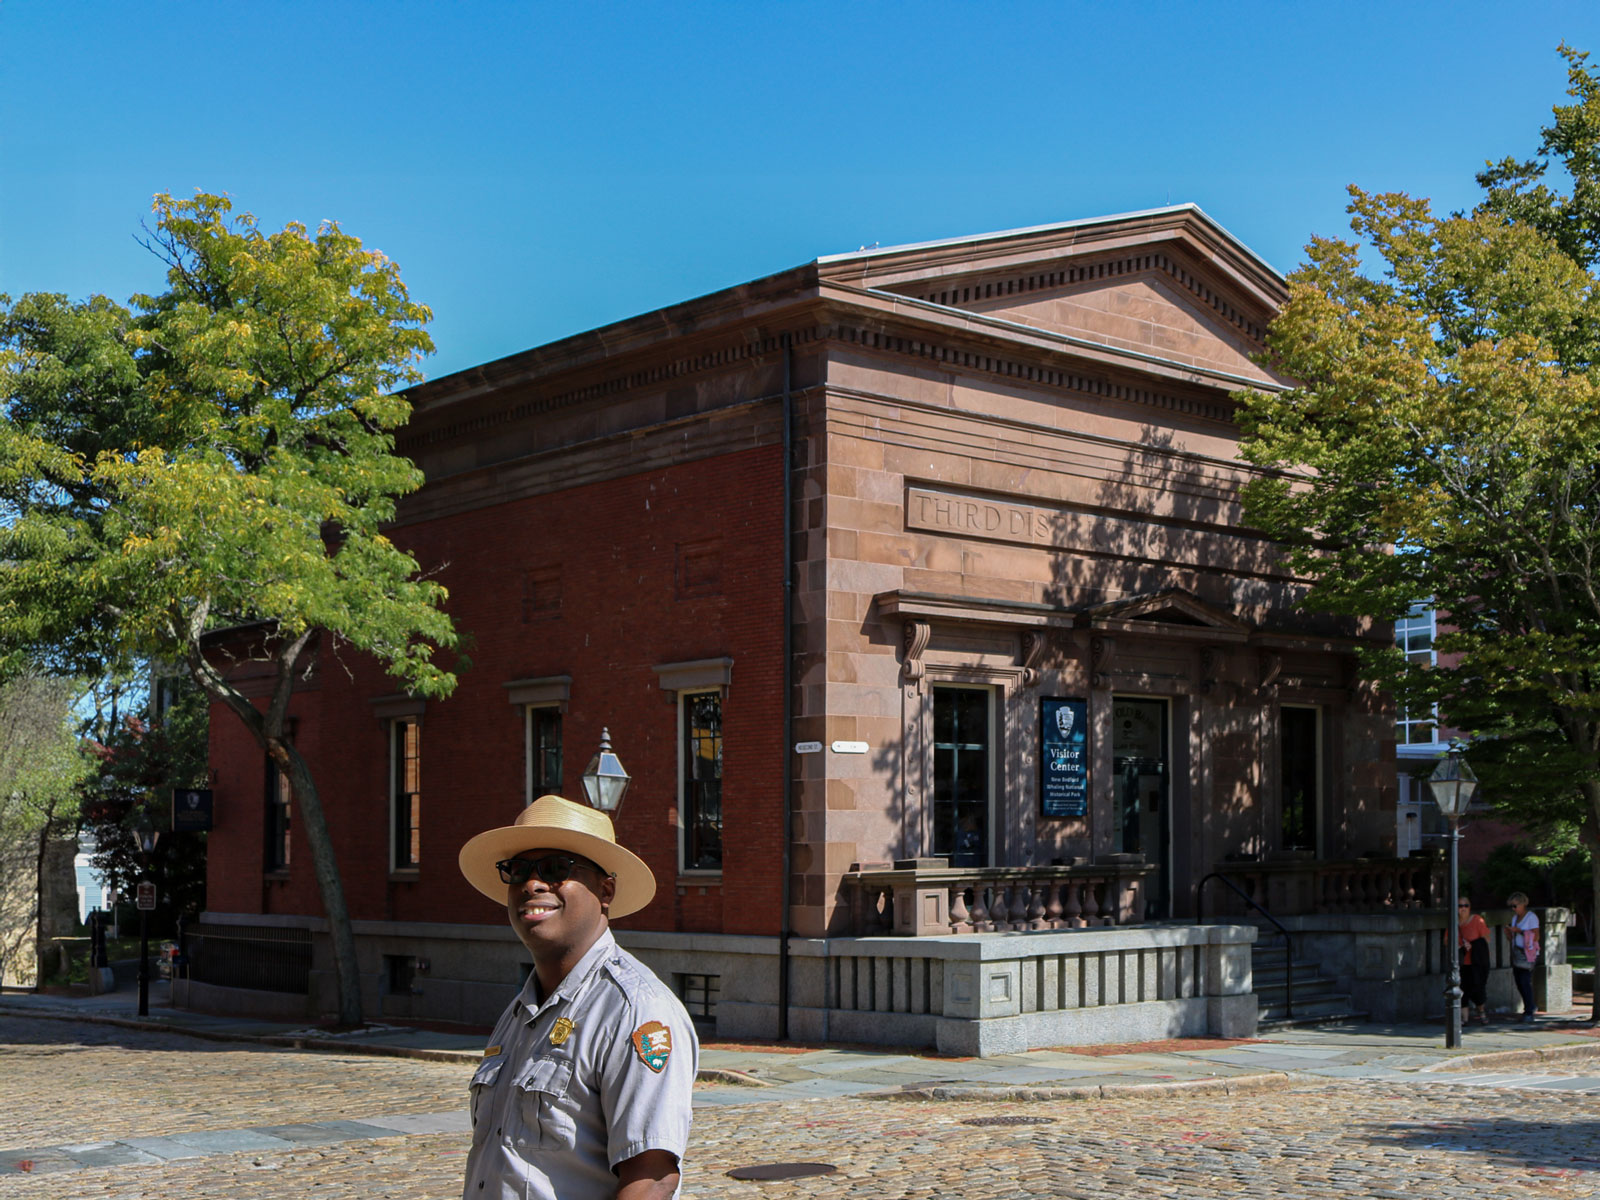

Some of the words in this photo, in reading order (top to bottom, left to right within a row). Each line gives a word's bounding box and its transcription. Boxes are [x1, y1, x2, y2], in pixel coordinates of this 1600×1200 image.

[914, 495, 1001, 532] THIRD
[1050, 748, 1080, 759] Visitor
[1050, 761, 1080, 772] Center
